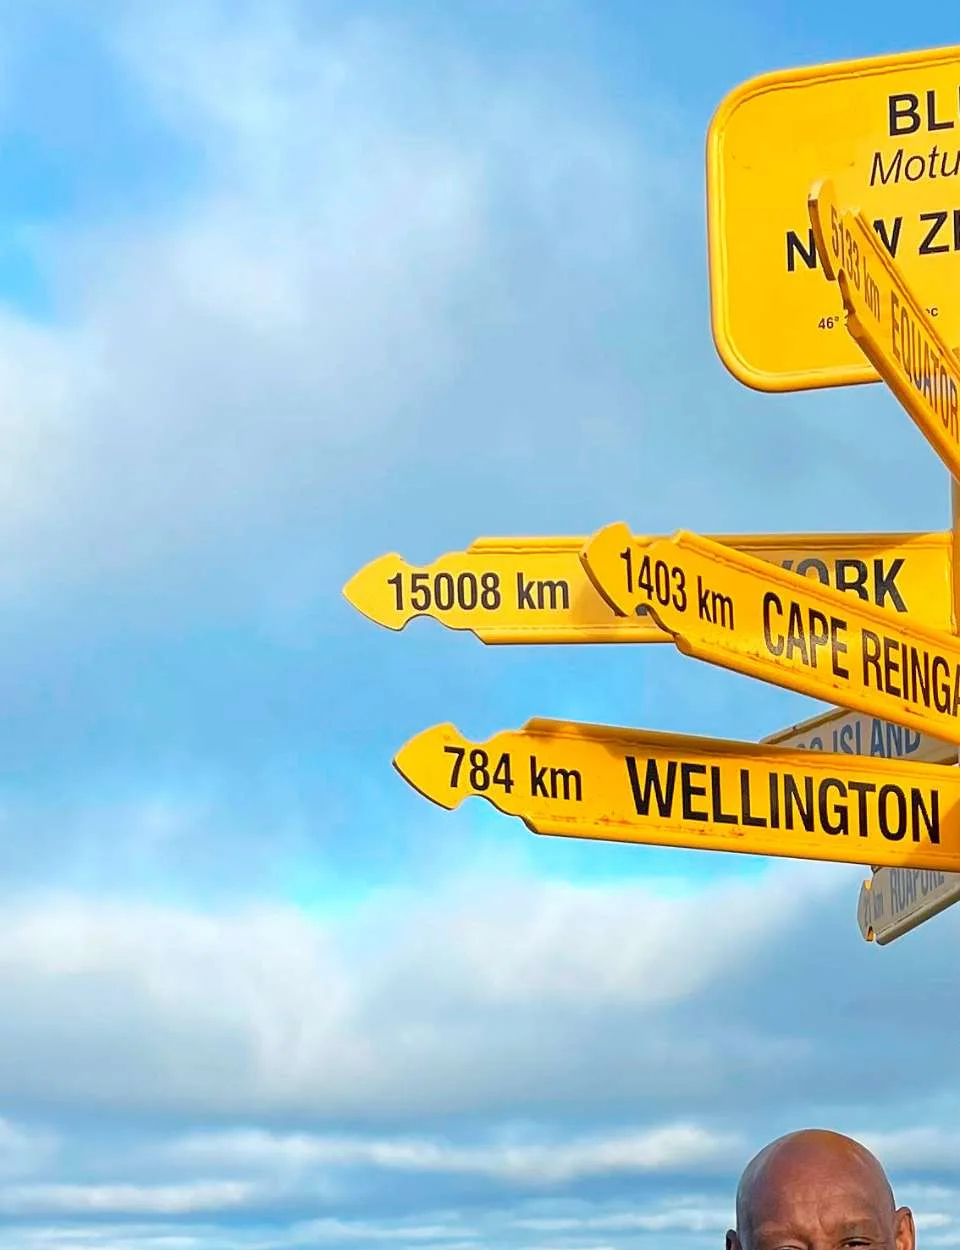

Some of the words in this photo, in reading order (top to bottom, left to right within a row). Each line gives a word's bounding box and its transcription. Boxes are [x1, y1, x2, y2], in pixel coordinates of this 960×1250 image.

[786, 216, 903, 272] NW
[831, 203, 861, 291] 5133
[863, 256, 881, 323] km
[818, 315, 839, 330] 46°
[890, 290, 959, 444] EQUATOR
[387, 572, 501, 611] 15008
[517, 570, 570, 611] km
[619, 547, 688, 613] 1403
[697, 575, 734, 631] km
[775, 558, 909, 613] RK
[763, 591, 848, 680] CAPE
[443, 746, 514, 794] 784
[530, 755, 583, 802] km
[625, 755, 940, 845] WELLINGTON
